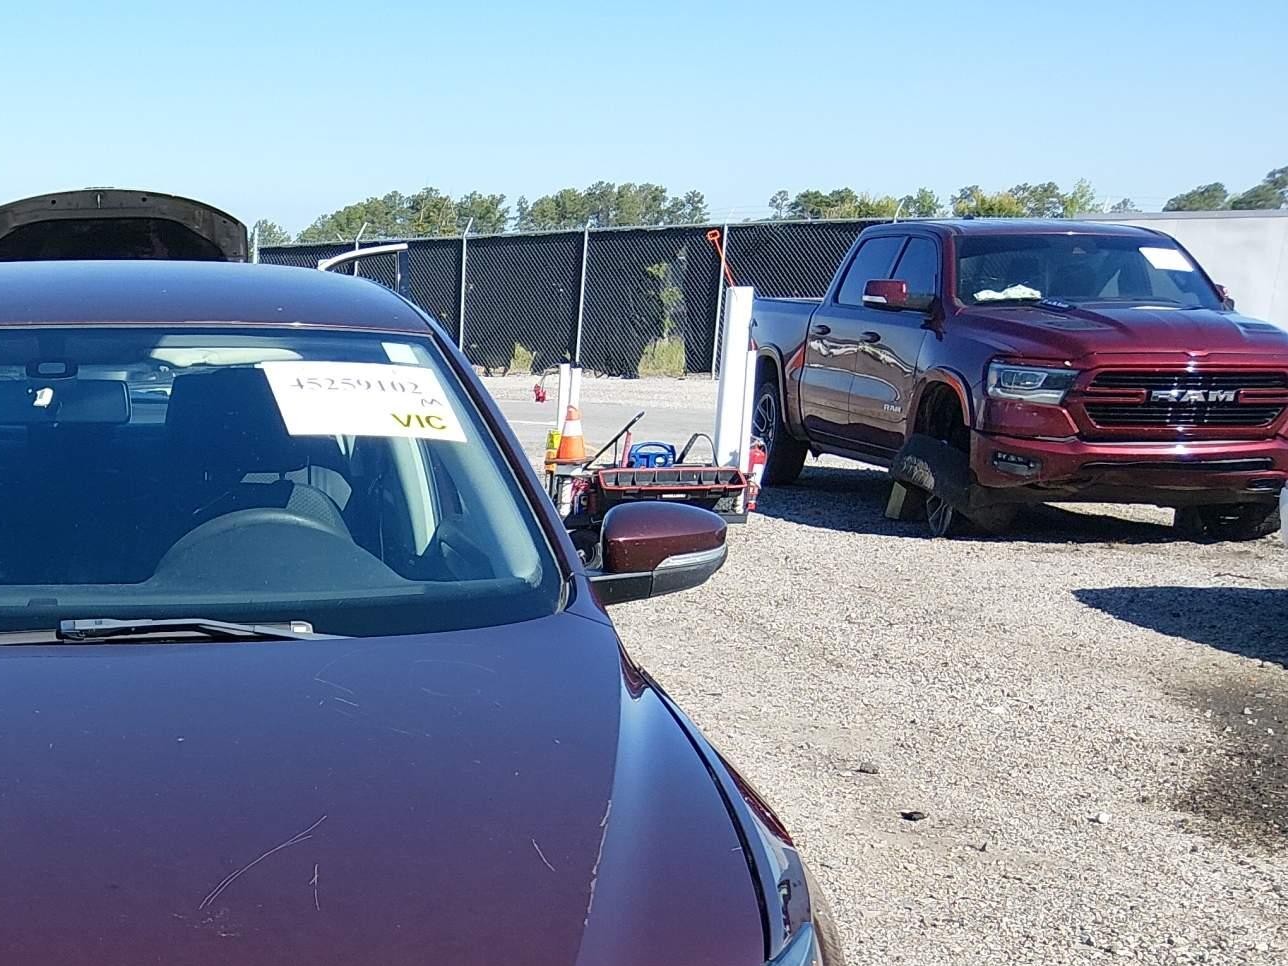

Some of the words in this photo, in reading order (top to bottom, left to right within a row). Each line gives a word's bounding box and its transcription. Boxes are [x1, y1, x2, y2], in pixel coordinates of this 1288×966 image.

[1151, 389, 1235, 402] RAM
[883, 404, 902, 412] RAM
[391, 413, 447, 430] VIC
